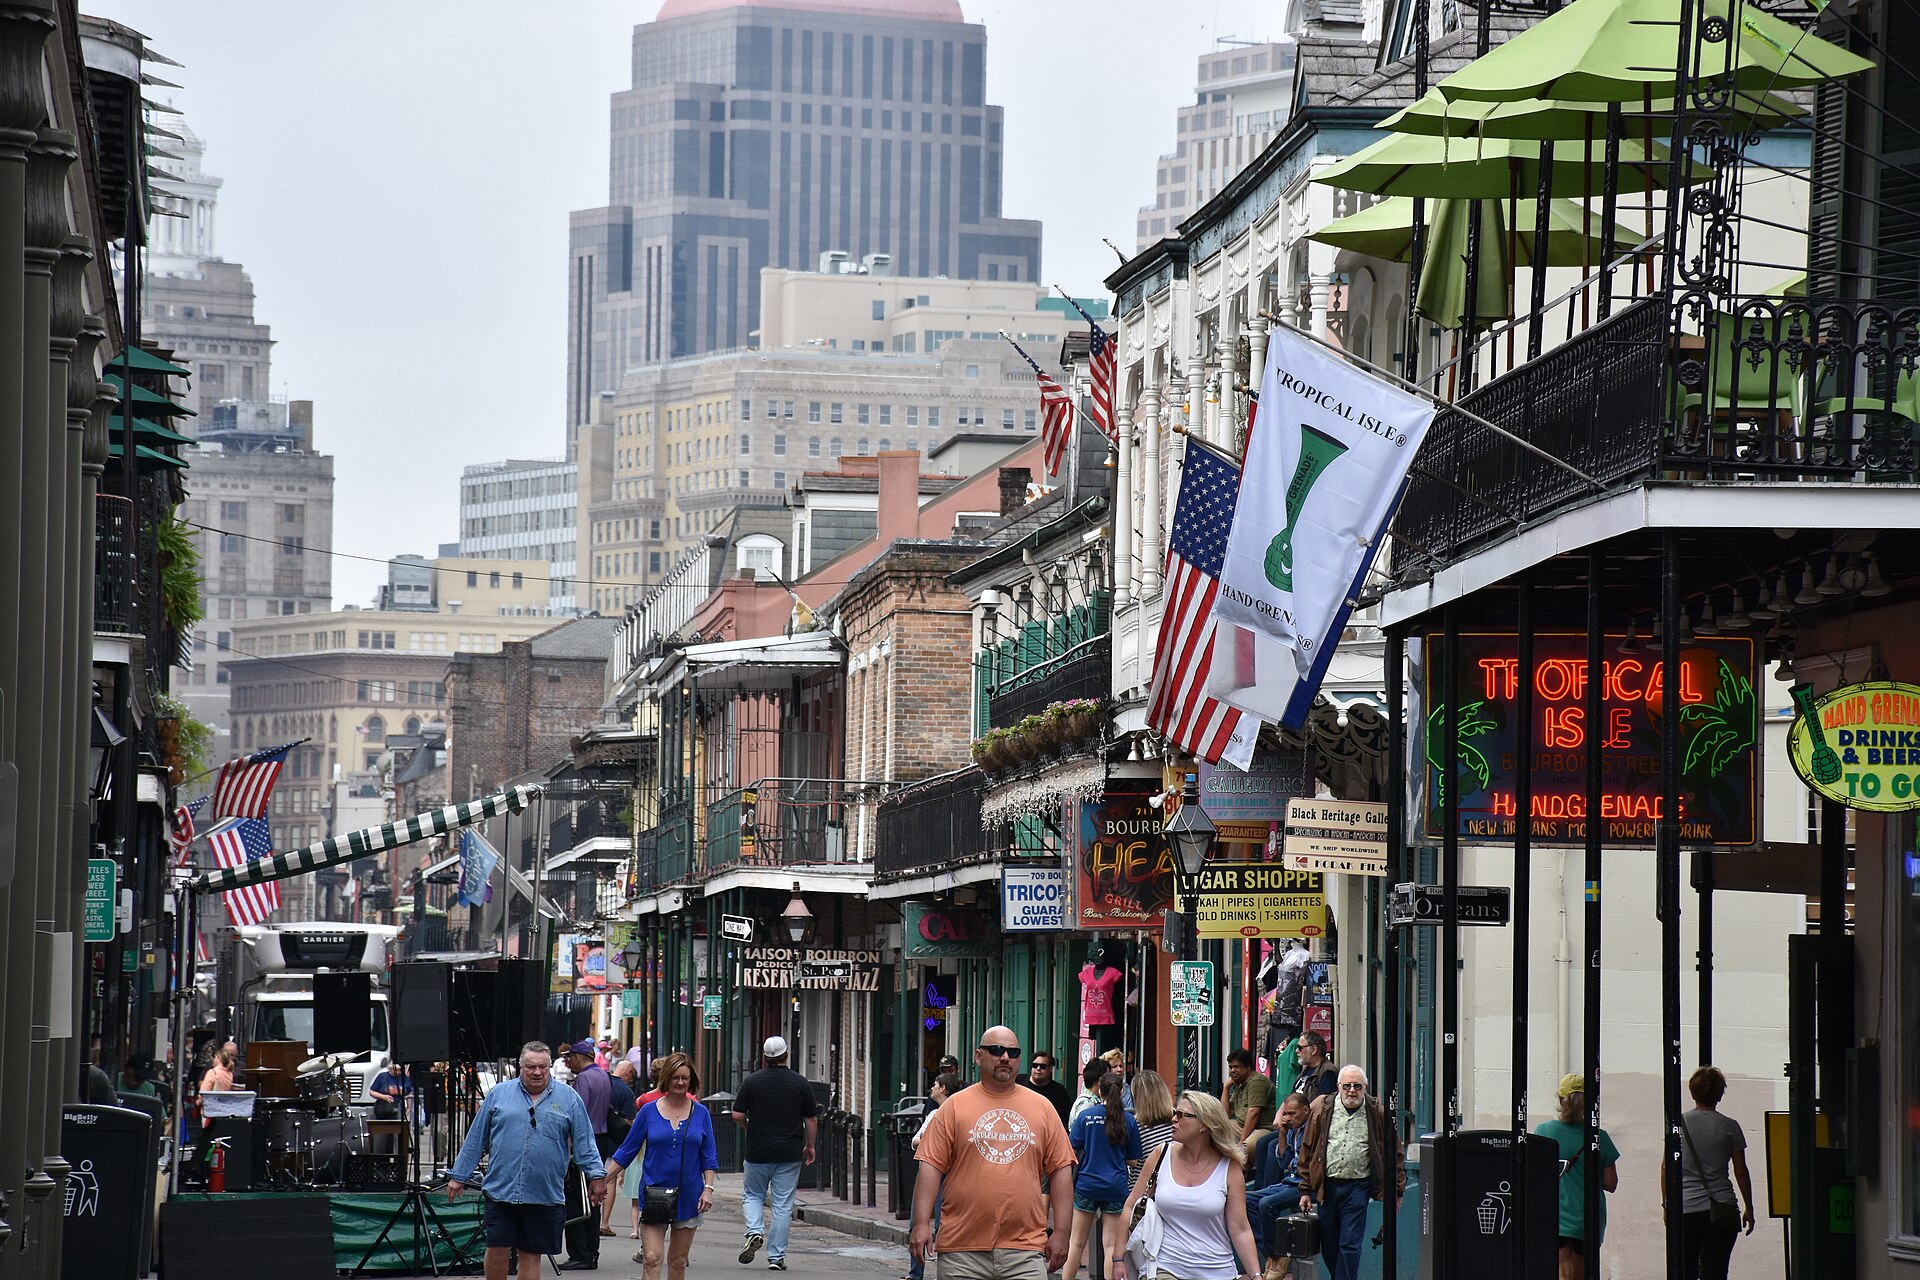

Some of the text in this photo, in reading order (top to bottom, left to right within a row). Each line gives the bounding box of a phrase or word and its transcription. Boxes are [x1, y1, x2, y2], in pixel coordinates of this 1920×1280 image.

[1276, 367, 1354, 421] TROPICAL
[1222, 583, 1253, 607] HAND
[1824, 695, 1867, 730] HAND
[1545, 707, 1631, 748] ISE
[1601, 754, 1660, 774] STREE
[1842, 747, 1860, 765] &
[1845, 773, 1881, 798] TO
[1136, 807, 1153, 815] 711
[1203, 798, 1232, 807] CUSTOM
[1292, 807, 1316, 820] Black
[1322, 809, 1360, 826] Heritage
[1220, 827, 1269, 838] GUARANTEED
[1468, 820, 1497, 836] NEW
[1502, 820, 1557, 837] ORANS
[1314, 860, 1355, 870] KODAK
[1031, 872, 1045, 880] 709
[1244, 870, 1320, 889] SHOPPE
[1105, 893, 1143, 911] GRILL
[1179, 896, 1322, 908] HKAH PIPES CIGARETTES
[1415, 897, 1500, 917] Oreans
[1220, 911, 1257, 921] DRINKS
[1265, 910, 1309, 921] T-SHIRTS
[725, 922, 735, 932] ONE
[1243, 926, 1318, 935] ATM ATM
[806, 949, 880, 964] BOURBON
[822, 966, 849, 976] Per
[845, 967, 880, 991] JAZZ
[977, 1110, 997, 1128] GREEN
[972, 1132, 1030, 1141] UKULELE ORCHESTRA
